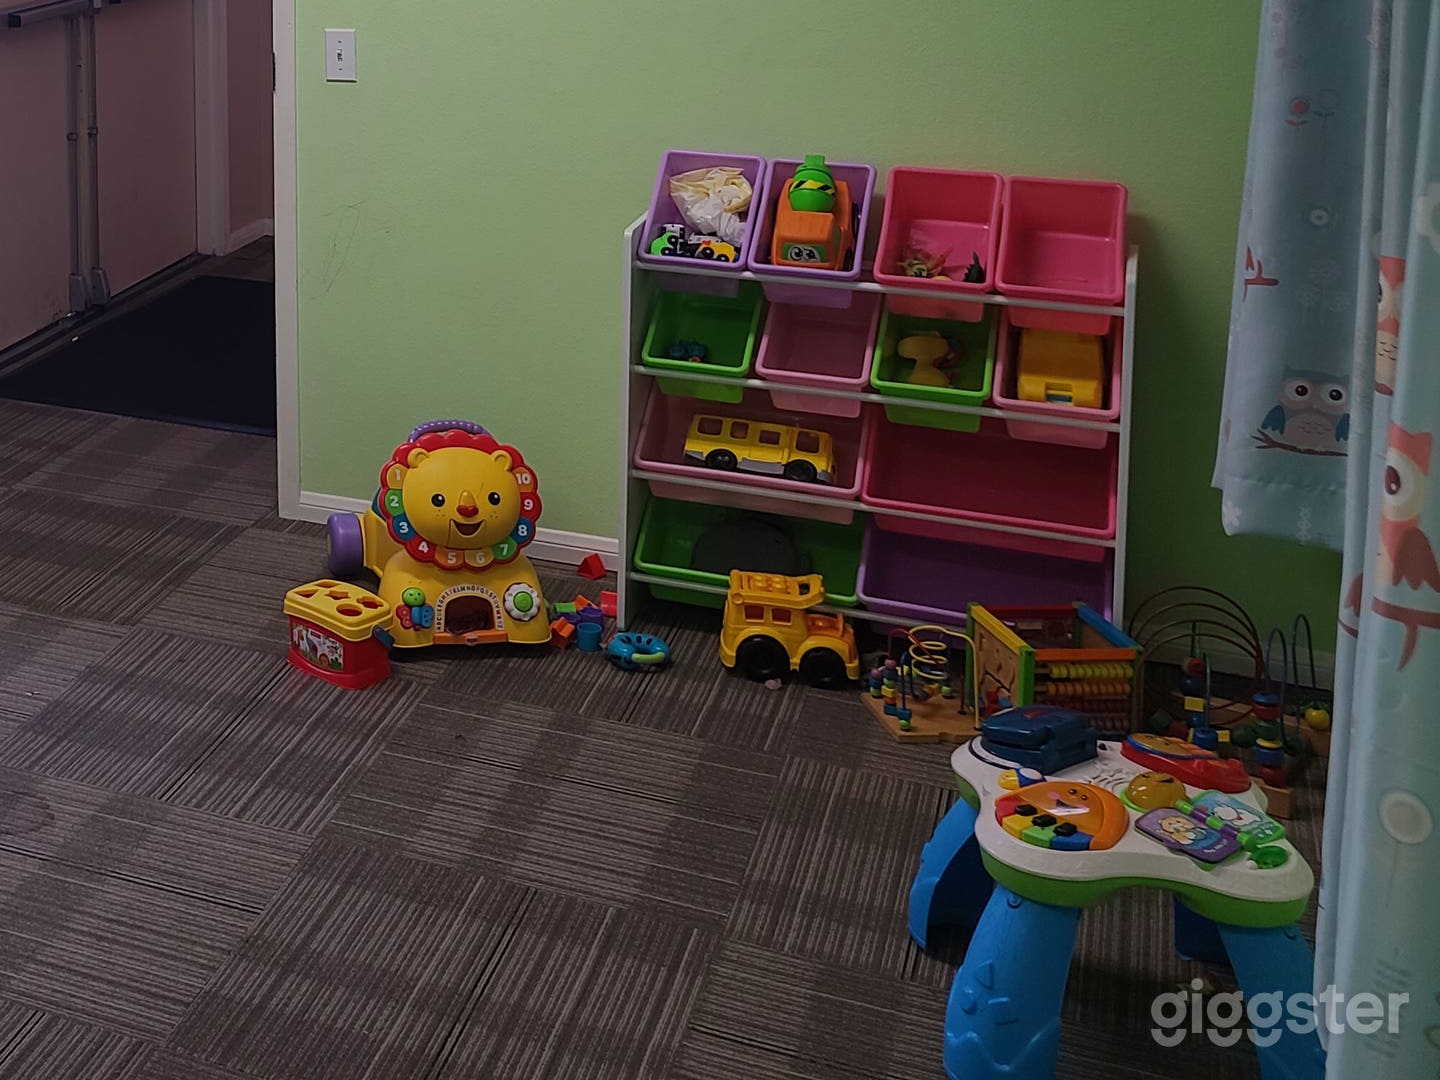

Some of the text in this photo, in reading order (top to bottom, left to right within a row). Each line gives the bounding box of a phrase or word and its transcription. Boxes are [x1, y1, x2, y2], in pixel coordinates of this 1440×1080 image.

[389, 469, 534, 564] 1 2 3 4 5 6 7 8 9 10
